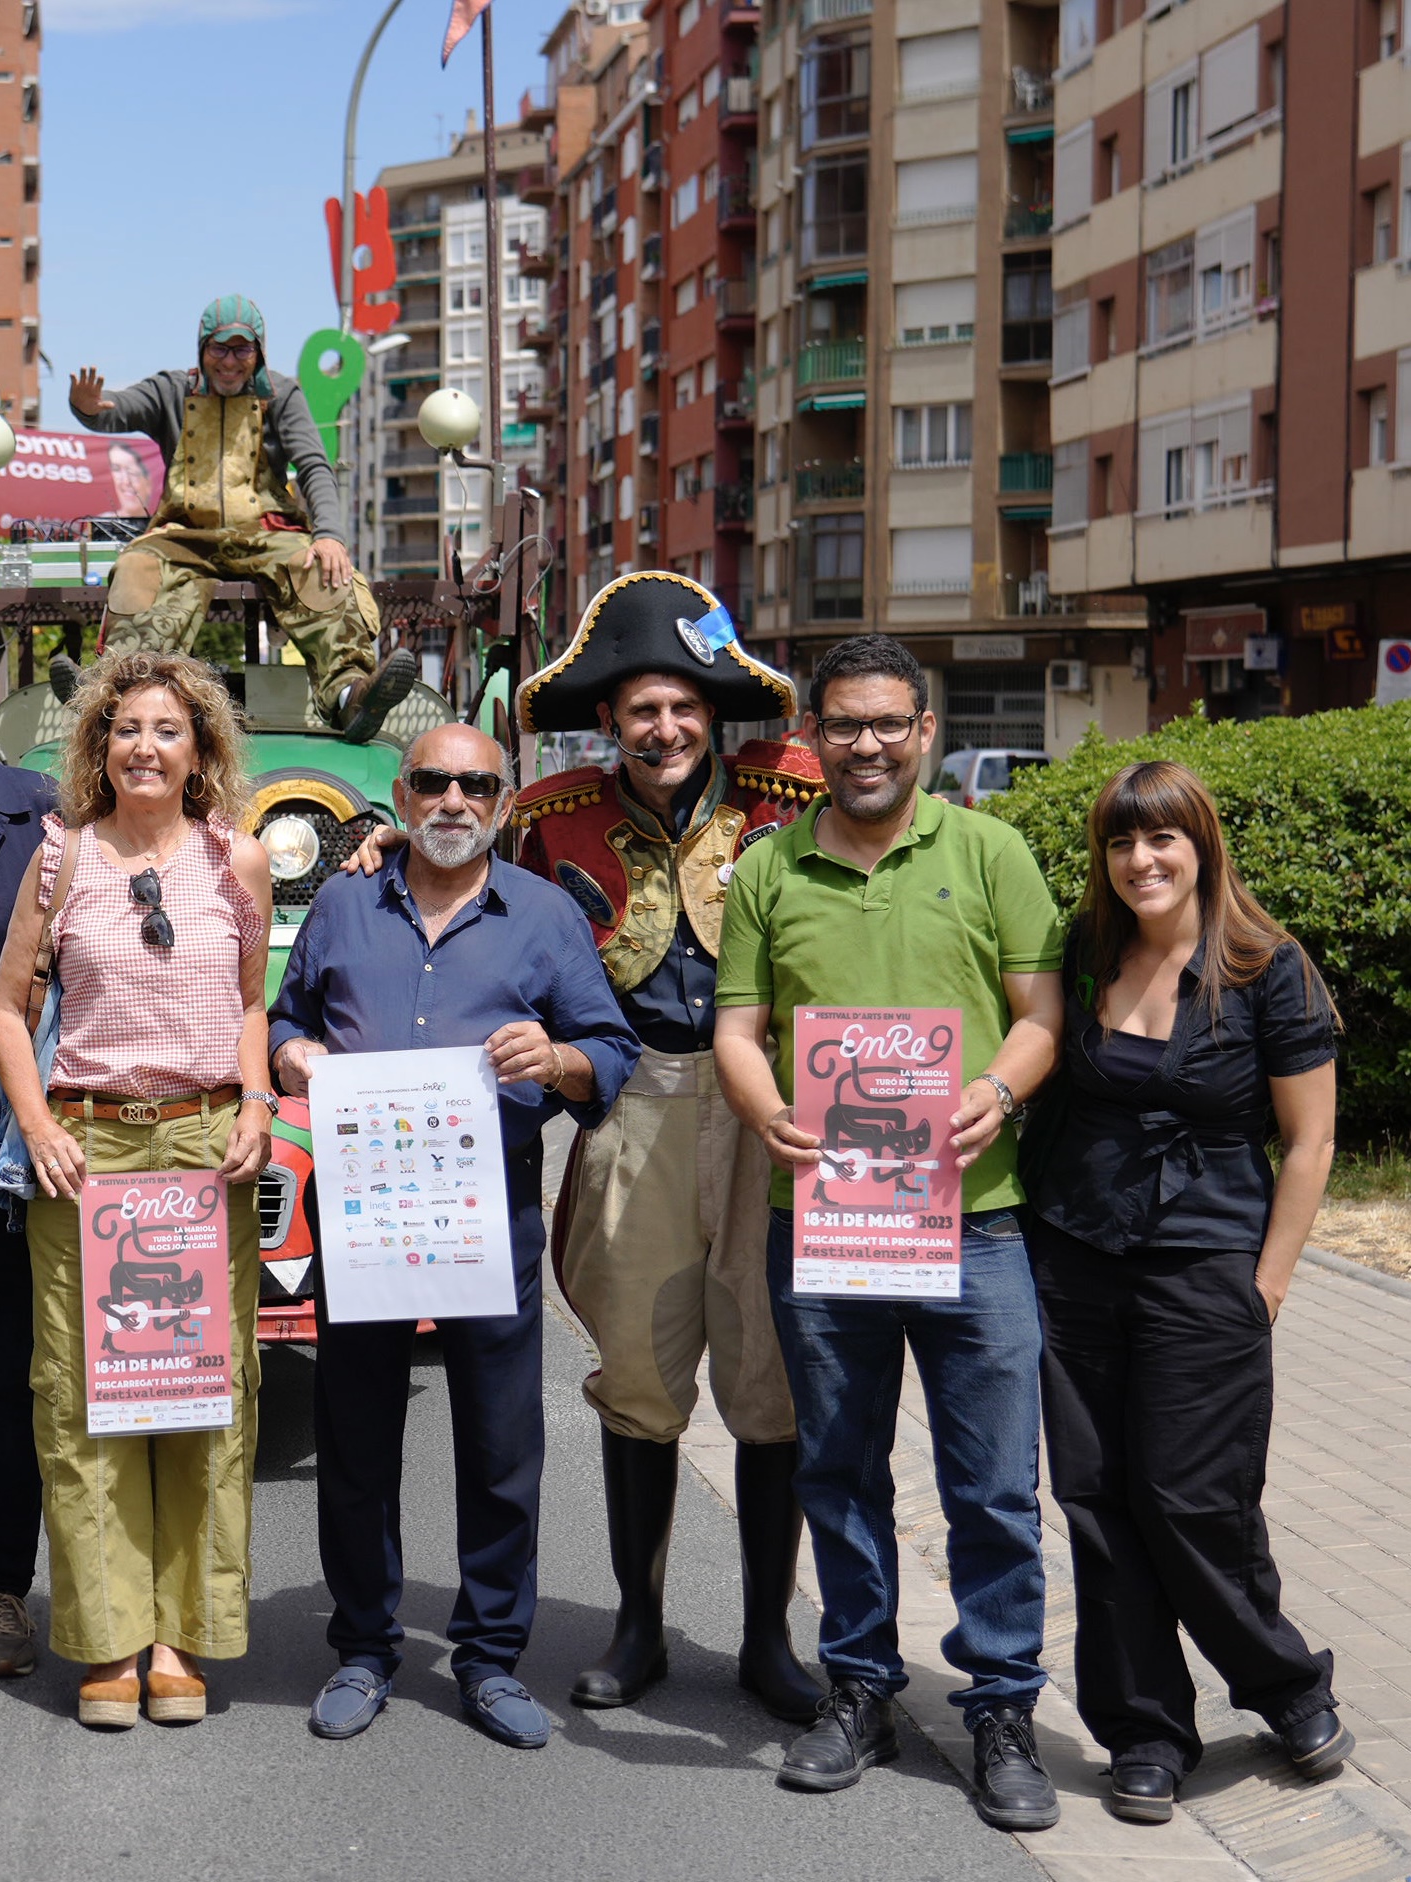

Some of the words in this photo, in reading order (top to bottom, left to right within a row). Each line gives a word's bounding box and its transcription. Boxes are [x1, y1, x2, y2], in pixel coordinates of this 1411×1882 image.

[14, 434, 87, 460] omú
[8, 460, 93, 484] coses
[747, 826, 773, 843] ROVER
[911, 1070, 949, 1078] MARIOLA
[875, 1078, 898, 1086] TURÓ
[98, 1178, 129, 1186] FESTIVAL
[803, 1212, 839, 1226] 18-21
[843, 1214, 864, 1227] DE
[868, 1214, 915, 1229] MAIG
[918, 1215, 953, 1229] 2023
[803, 1235, 877, 1245] DESCARREGA'T
[892, 1238, 953, 1248] PROGRAMA
[803, 1246, 952, 1260] festivalenre9.com
[94, 1360, 126, 1374] 18-21
[129, 1359, 148, 1372] DE
[151, 1357, 192, 1370] MAIG
[196, 1355, 225, 1368] 2023
[95, 1378, 160, 1390] DESCARREGA'T
[172, 1375, 225, 1384] PROGRAMA
[95, 1385, 225, 1401] festivalenre9.com
